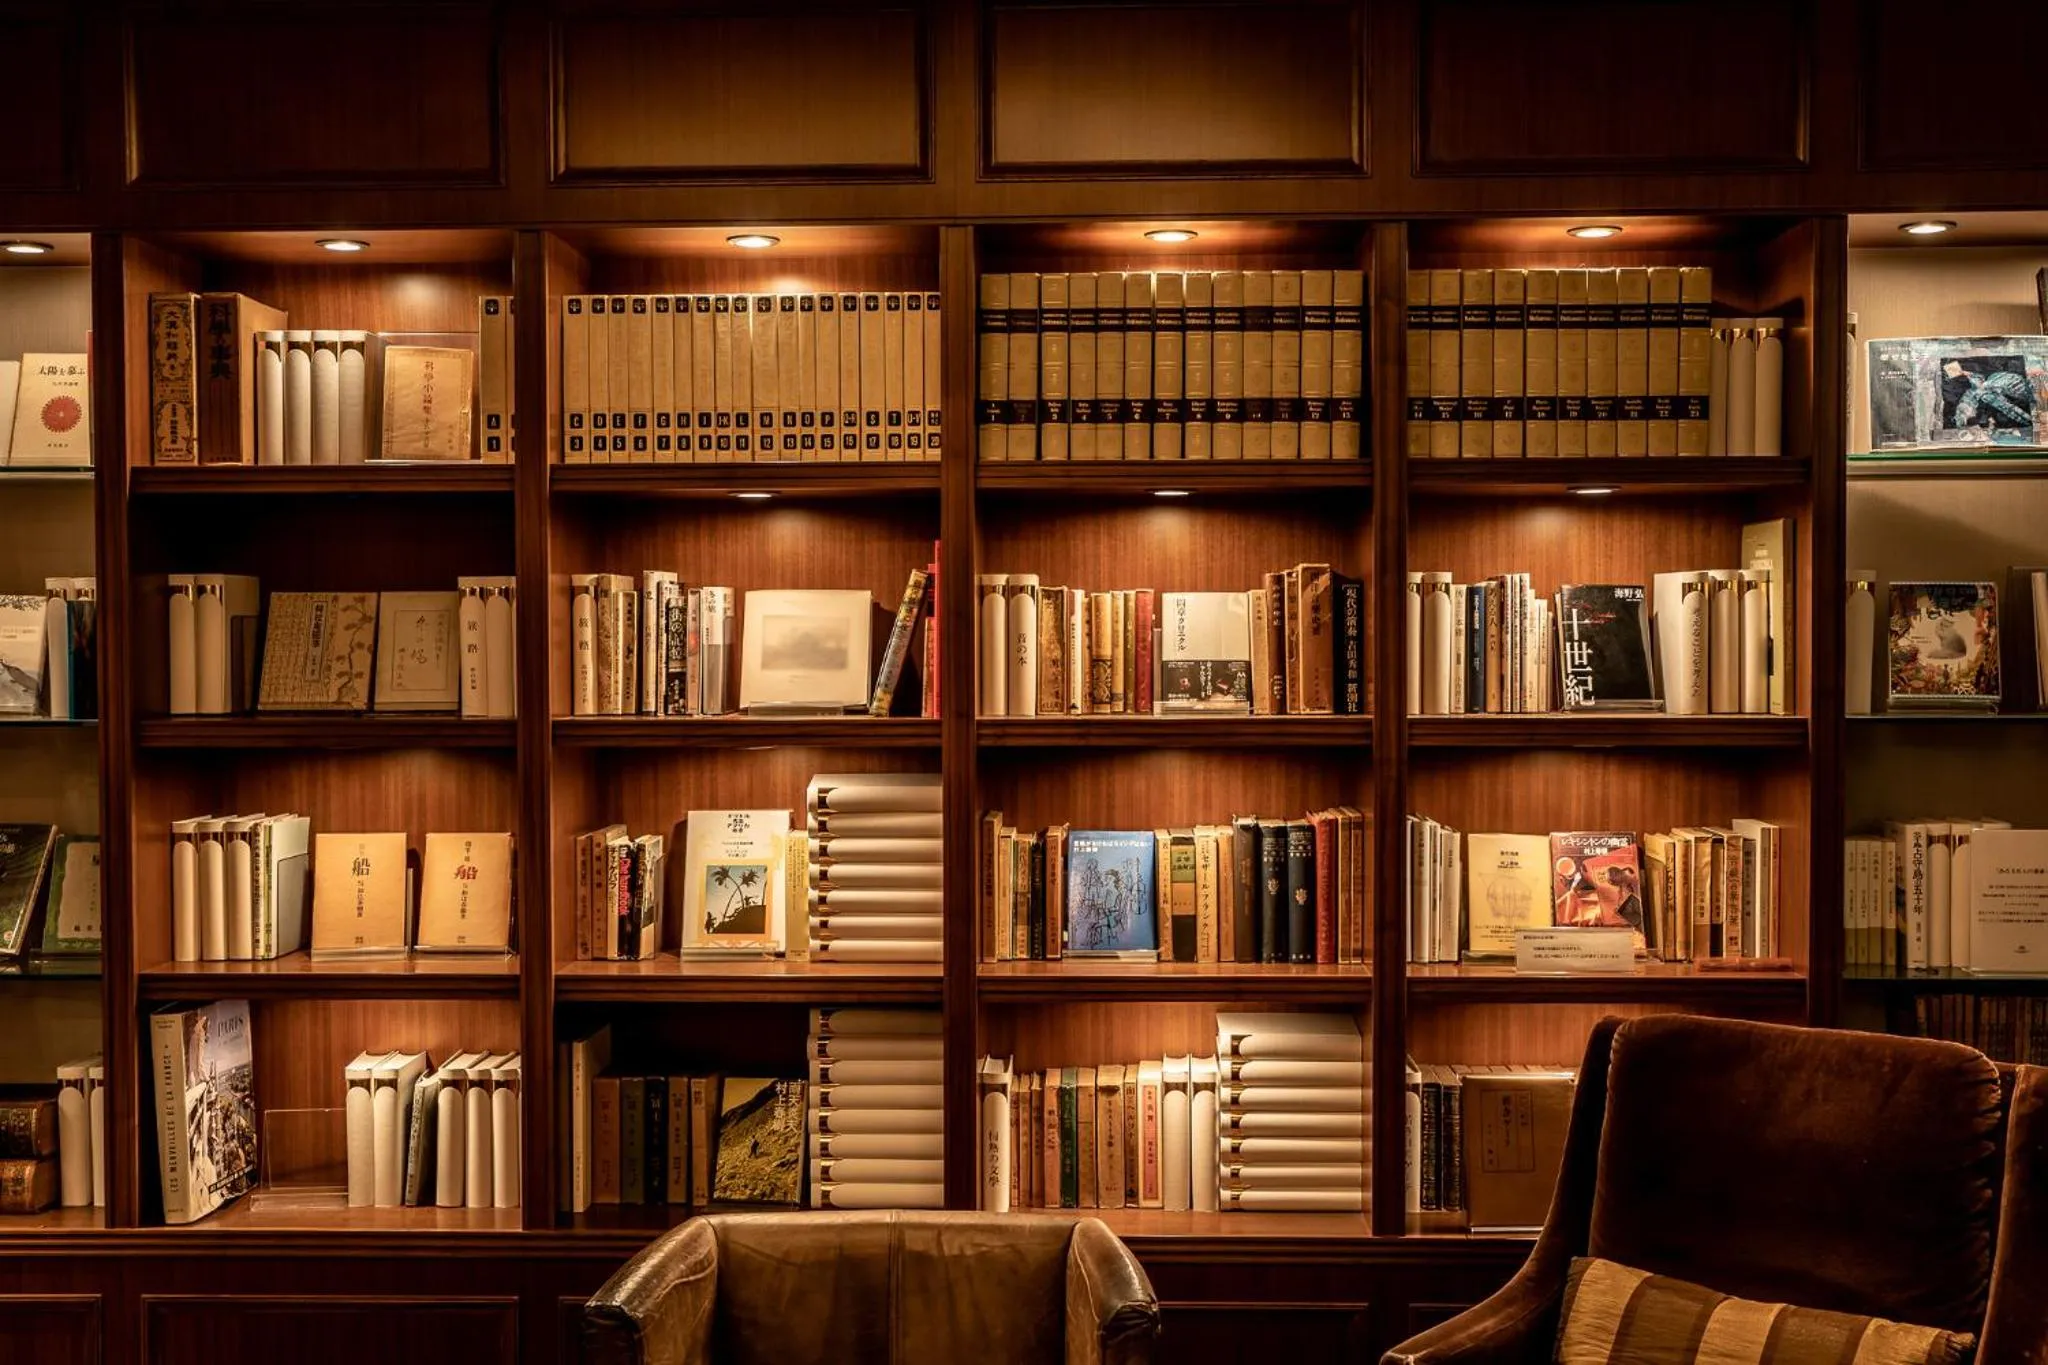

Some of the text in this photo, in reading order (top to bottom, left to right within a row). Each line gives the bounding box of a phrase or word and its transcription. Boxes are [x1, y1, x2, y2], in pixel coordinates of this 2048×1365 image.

[1614, 587, 1645, 599] 海野弘
[1561, 837, 1631, 847] レキシントンの幽霊
[217, 1017, 245, 1037] PARIS
